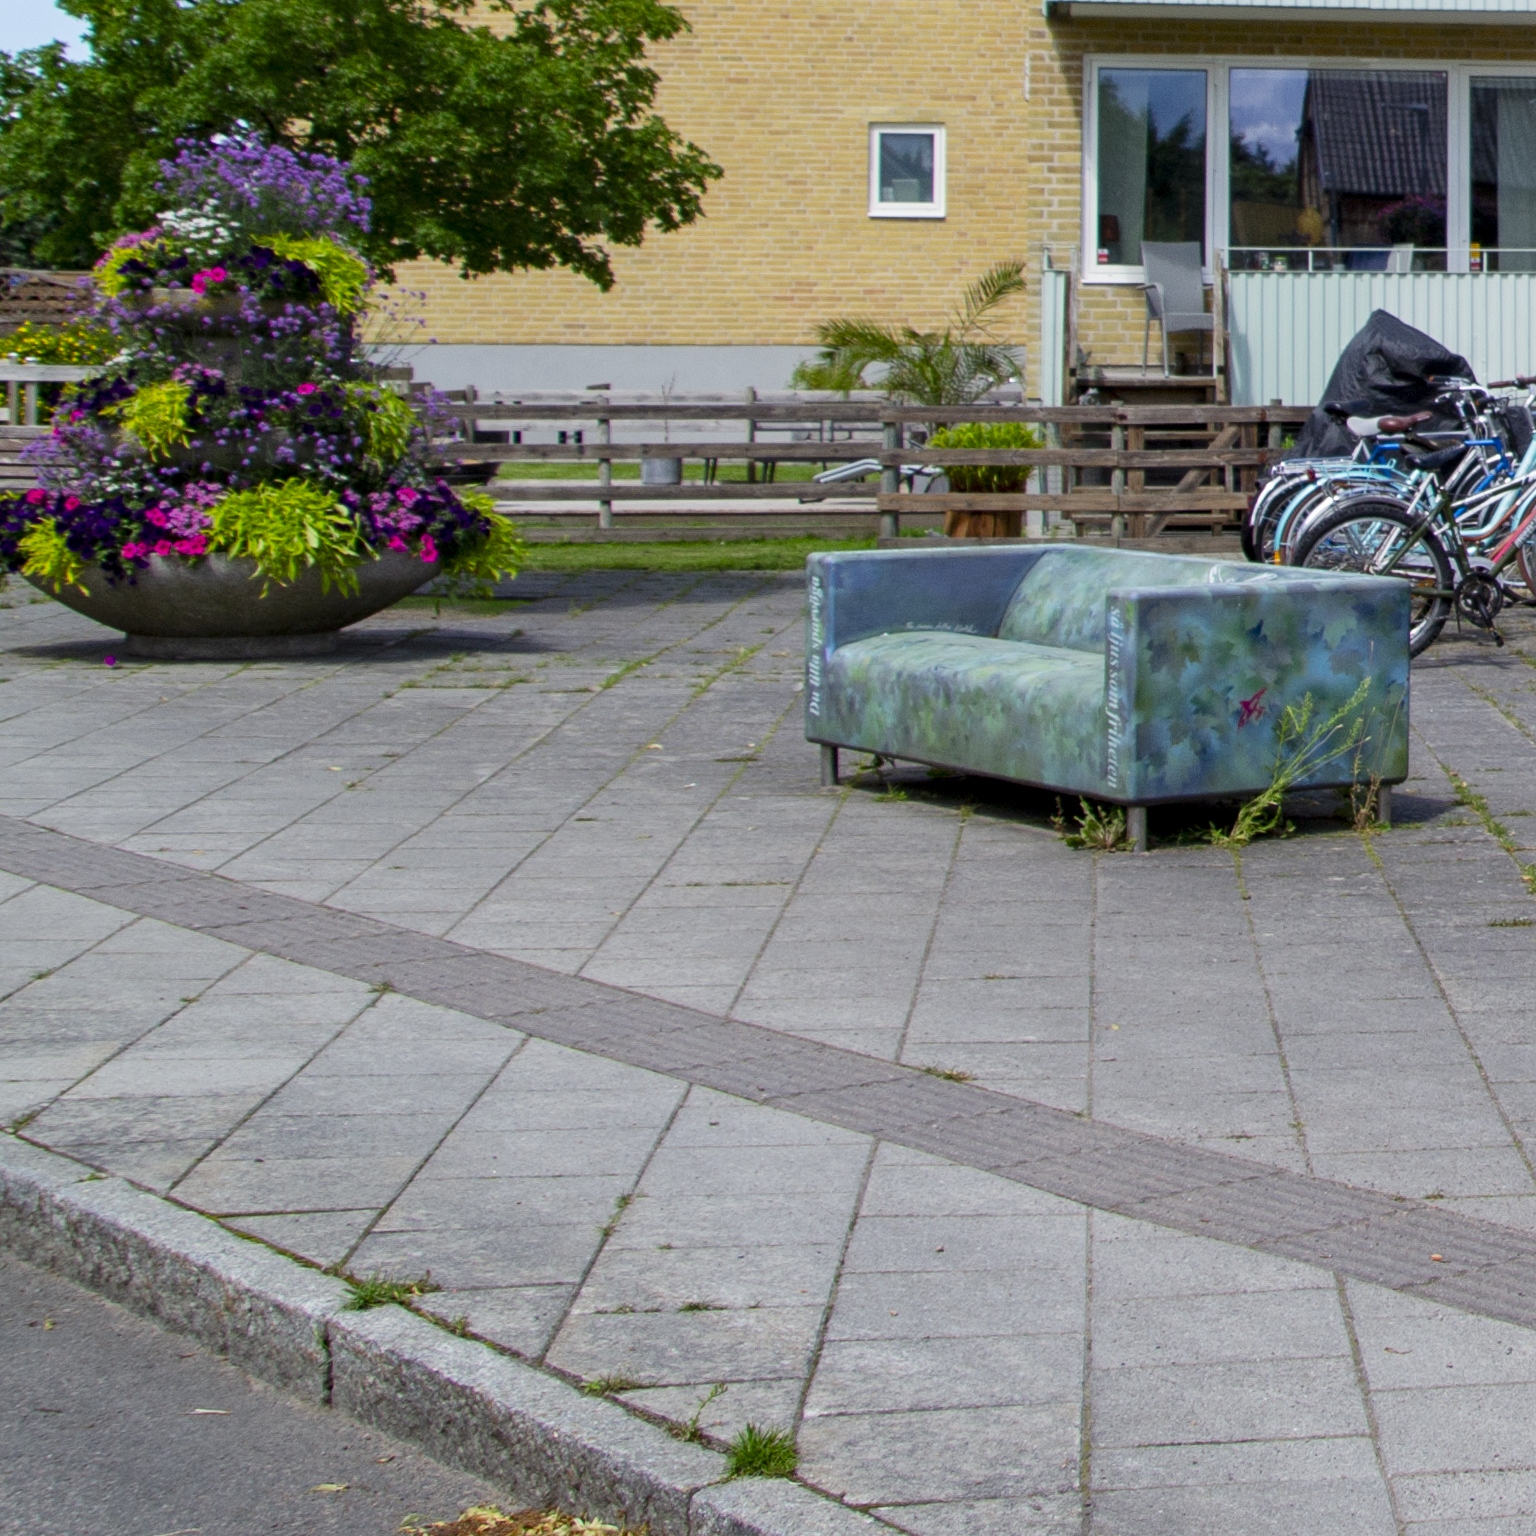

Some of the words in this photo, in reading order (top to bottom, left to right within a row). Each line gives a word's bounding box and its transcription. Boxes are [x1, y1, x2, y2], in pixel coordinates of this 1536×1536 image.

[809, 575, 823, 651] sparvöga
[1110, 606, 1123, 629] så
[1108, 631, 1123, 666] ljus
[809, 655, 820, 687] lilla
[809, 691, 820, 716] Du
[1109, 669, 1120, 709] som
[1105, 706, 1122, 789] friheten
